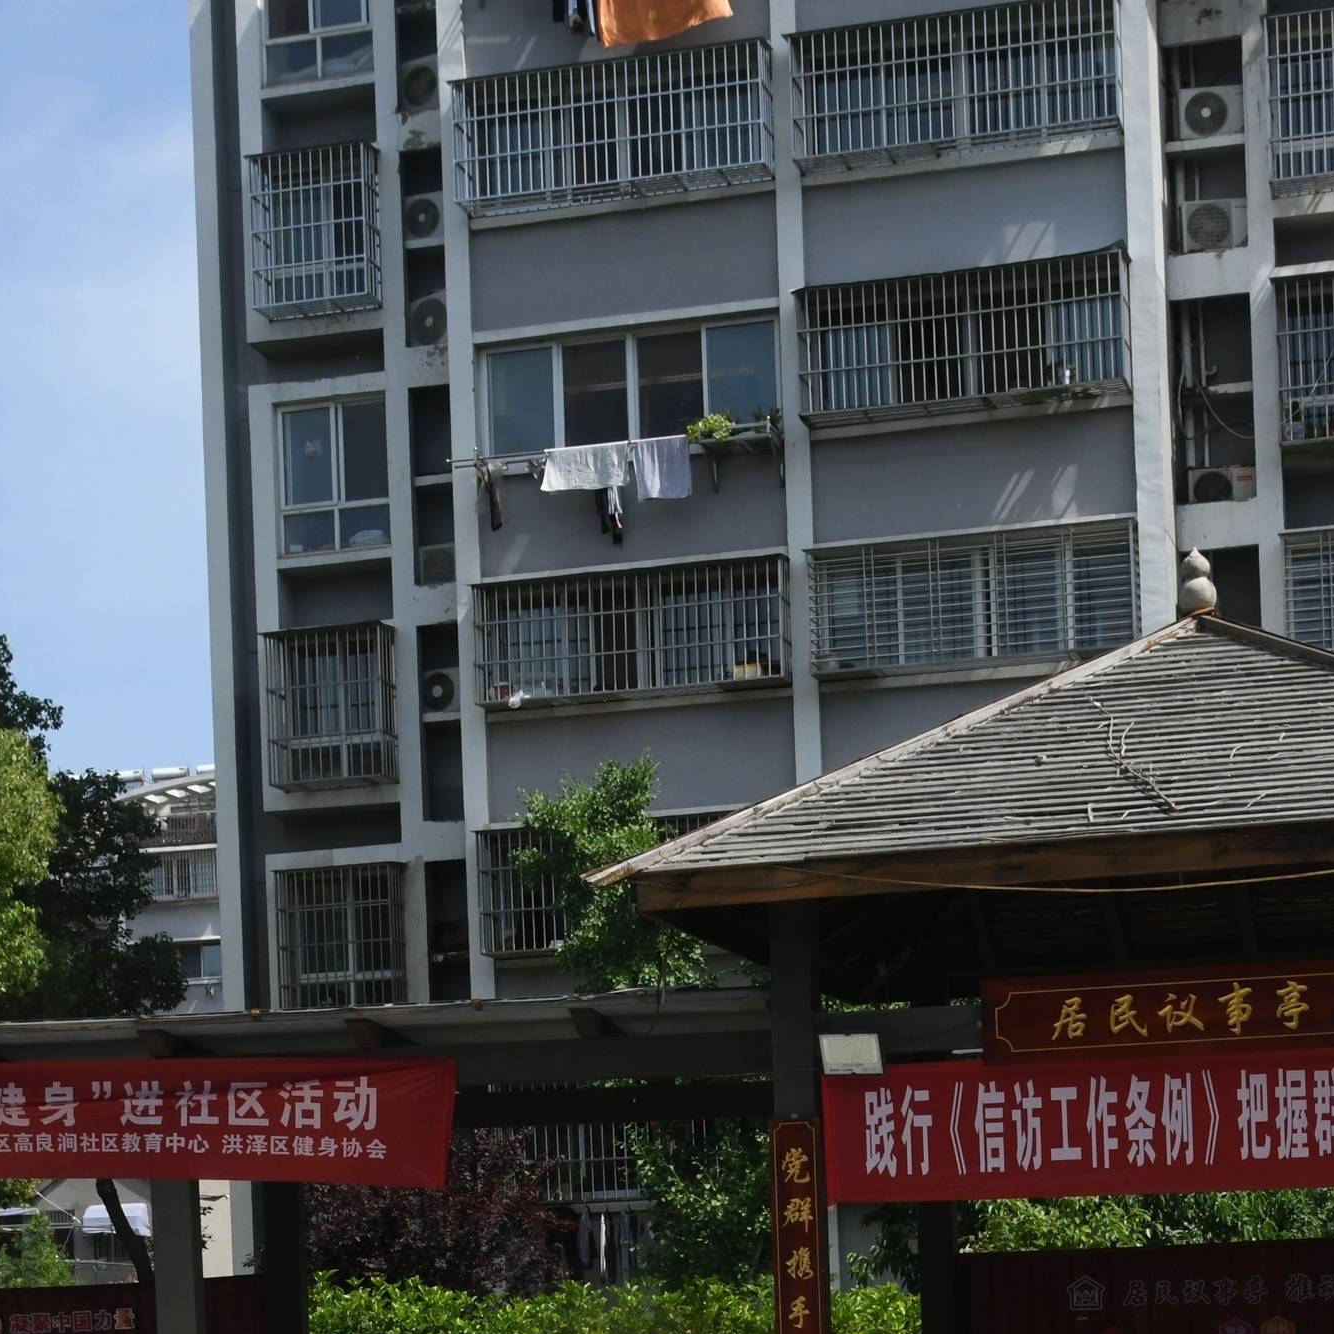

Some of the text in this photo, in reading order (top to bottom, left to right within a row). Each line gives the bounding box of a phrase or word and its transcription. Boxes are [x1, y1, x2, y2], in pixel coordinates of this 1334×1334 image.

[1051, 980, 1310, 1041] 居民议事亭
[221, 1133, 388, 1160] 洪泽区健身协会
[8, 1307, 136, 1334] 凝聚中国力量
